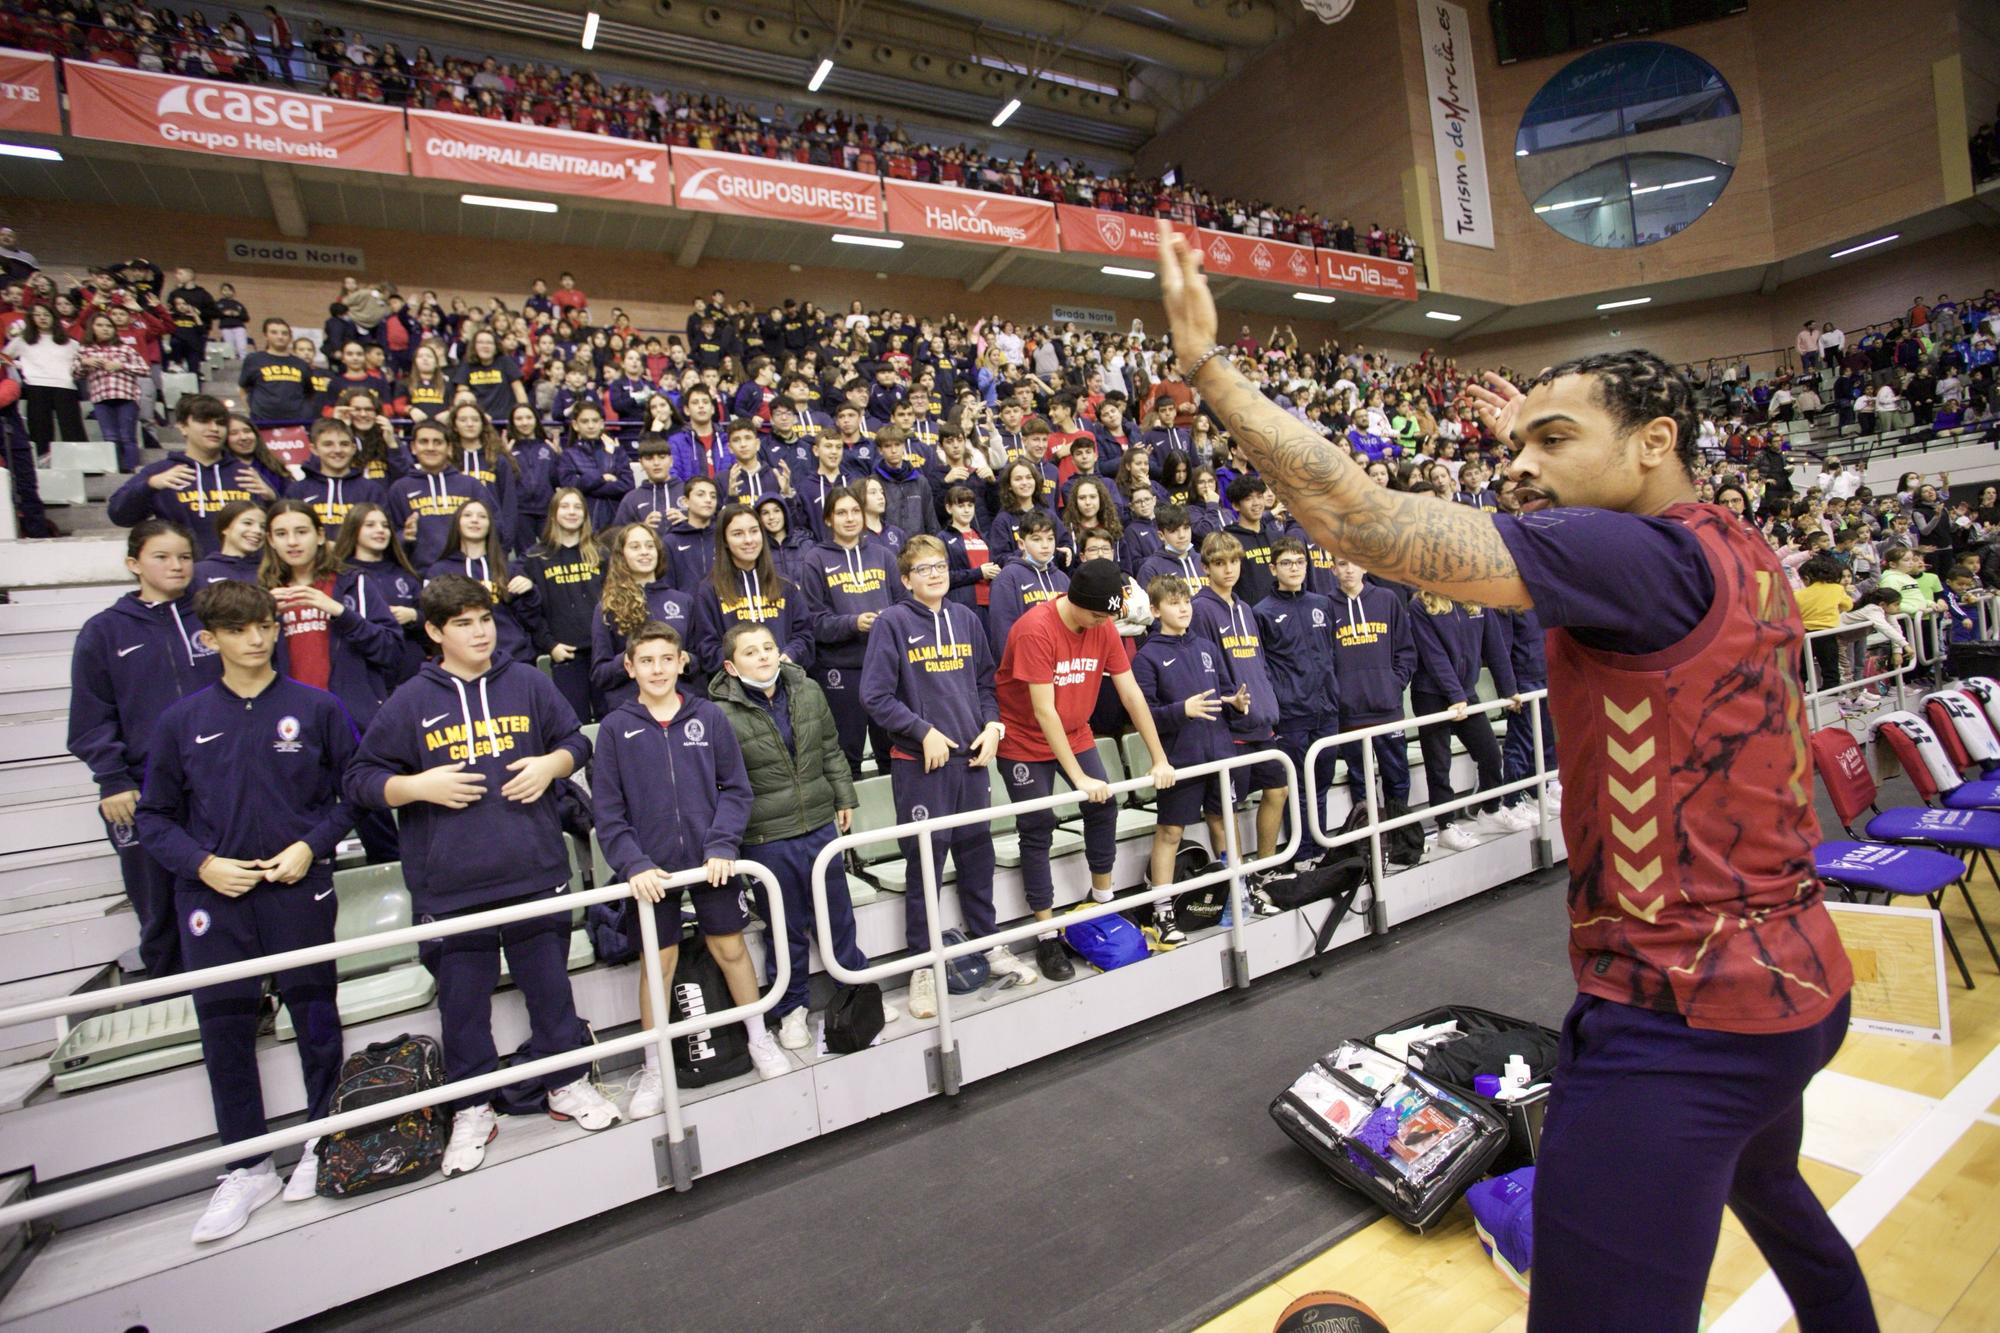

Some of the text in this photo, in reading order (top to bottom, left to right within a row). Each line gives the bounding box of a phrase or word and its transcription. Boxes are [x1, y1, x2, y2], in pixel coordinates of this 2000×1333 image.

[193, 88, 334, 132] caser
[158, 122, 338, 159] Grupo Helvetia
[426, 137, 626, 180] COMPRALAENTRADA
[716, 174, 877, 216] GRUPOSURESTE
[234, 244, 358, 265] Grada Norte
[1055, 308, 1113, 322] Grada Norte
[908, 647, 938, 663] ALMA
[925, 658, 964, 672] COLEGIOS
[425, 715, 530, 752] ALMA MATER
